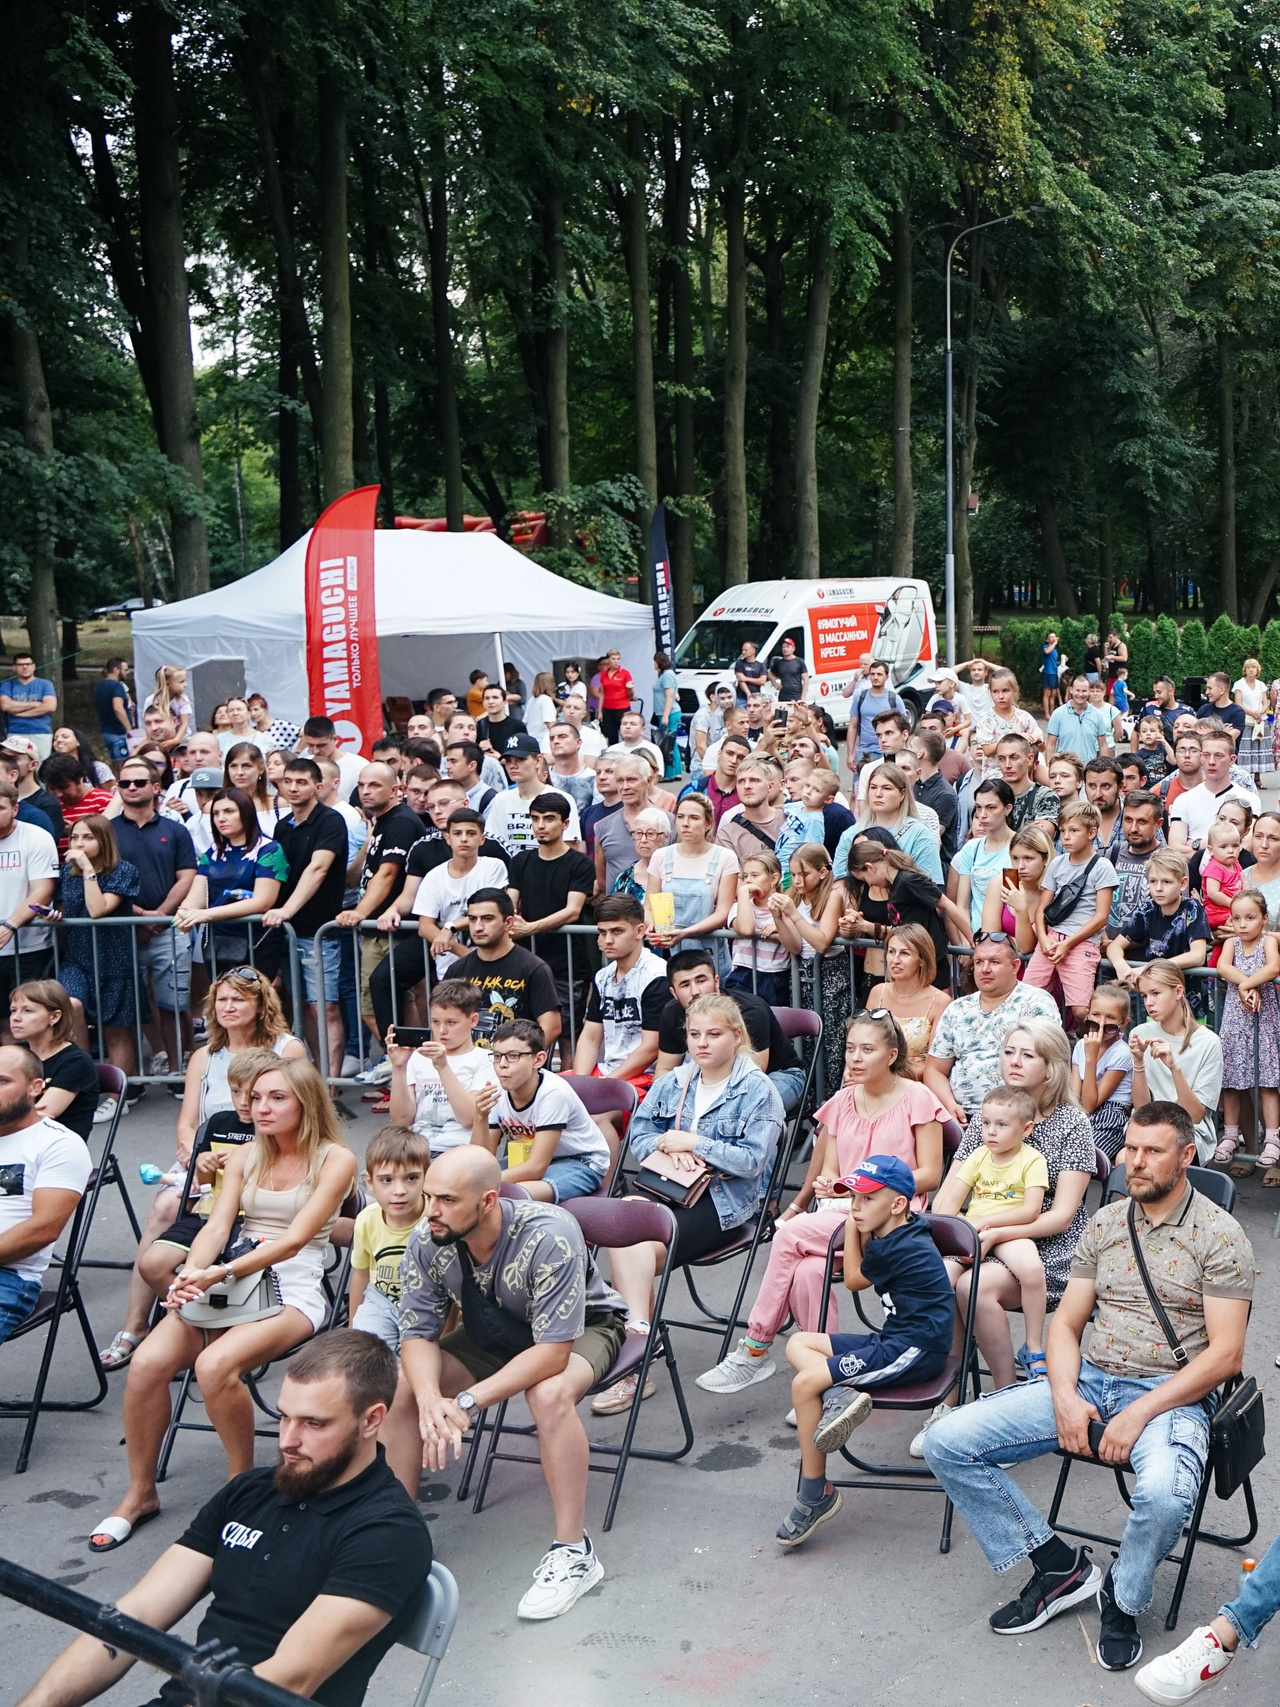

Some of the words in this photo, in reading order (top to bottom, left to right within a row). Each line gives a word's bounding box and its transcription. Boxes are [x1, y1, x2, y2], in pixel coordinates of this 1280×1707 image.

[726, 606, 774, 614] YAMAGUCHI
[346, 595, 358, 642] ЛУЧШЕЕ
[817, 615, 857, 630] #ЯМОГУЧИЙ
[319, 557, 351, 718] YAMAGUCHI
[819, 634, 826, 644] В
[826, 630, 869, 643] МАССАЖНОМ
[820, 646, 846, 659] КРЕСЛЕ
[350, 642, 362, 689] ТОЛЬКО
[1115, 862, 1147, 874] ALLIANCE
[482, 975, 503, 990] КАК
[503, 978, 526, 991] ОСА
[226, 1132, 246, 1141] STREET
